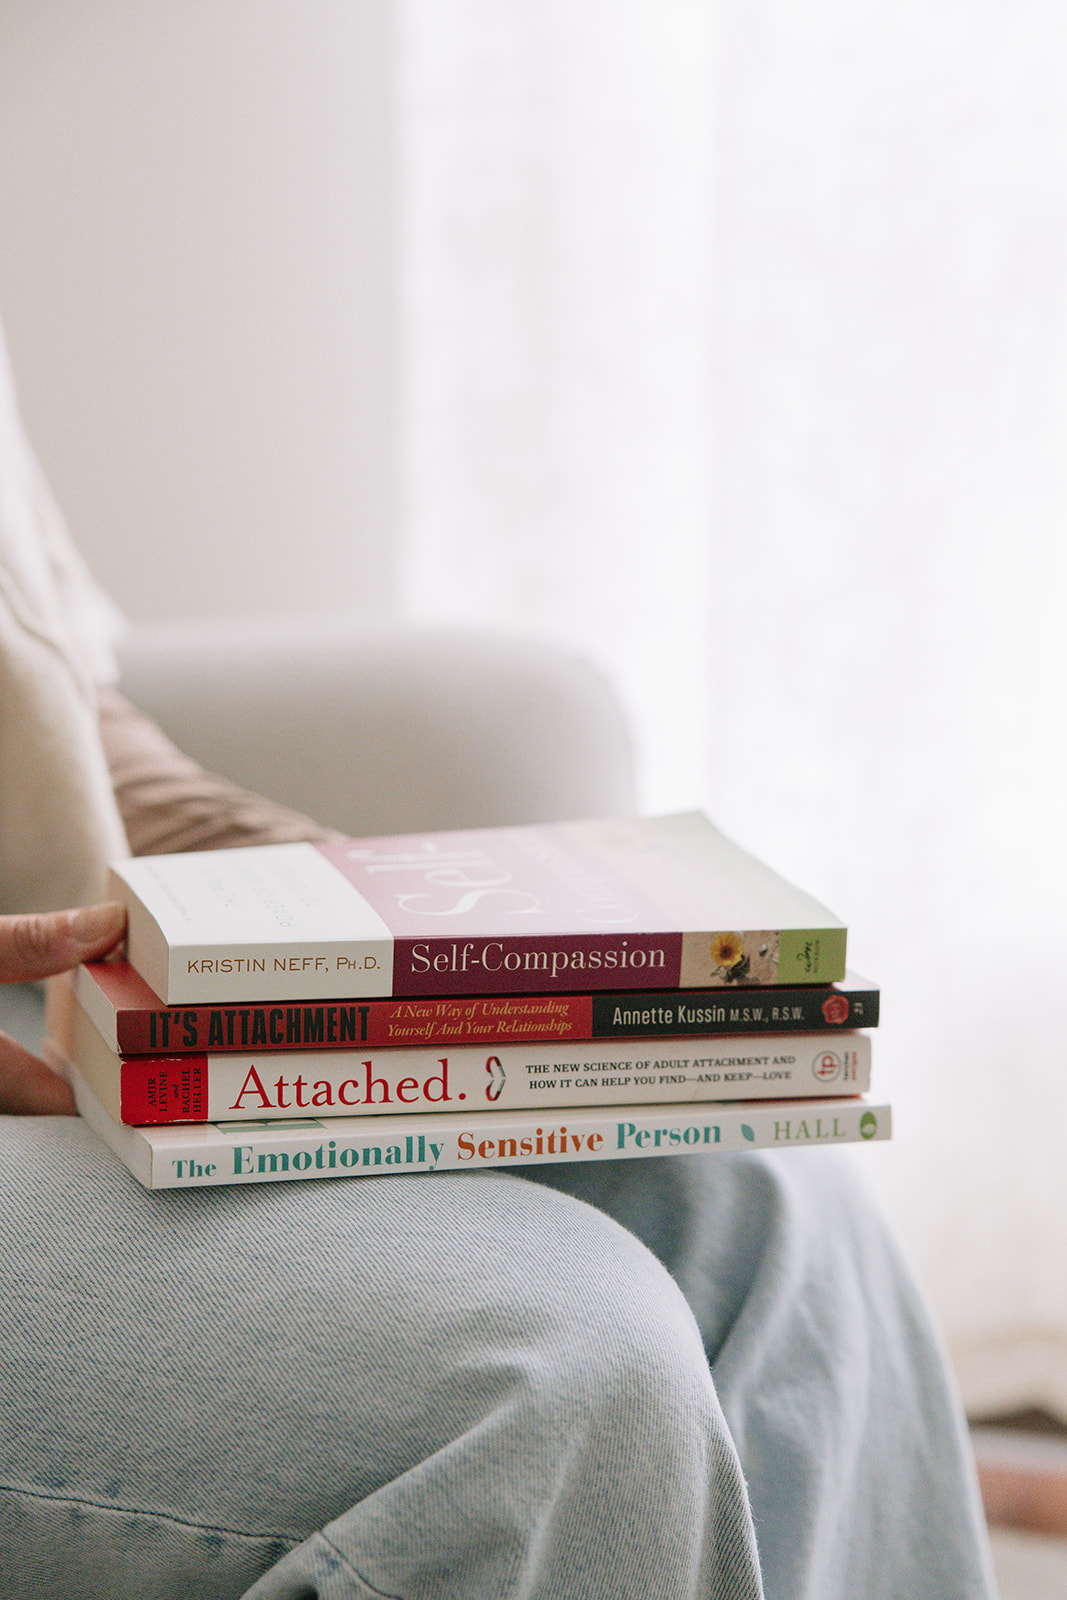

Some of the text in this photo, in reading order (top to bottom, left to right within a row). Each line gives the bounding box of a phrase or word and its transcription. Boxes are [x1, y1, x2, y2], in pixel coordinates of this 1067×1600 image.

[187, 959, 265, 973] KRISTIN
[274, 957, 329, 973] NEFF,
[410, 941, 666, 978] Self-Compassion
[390, 1000, 570, 1020] A New Way of Understanding
[613, 1006, 673, 1025] Annette
[678, 1005, 725, 1023] Kussin
[772, 1006, 805, 1021] R.S.W.
[149, 1006, 370, 1048] IT'S ATTACHMENT
[387, 1018, 573, 1039] Yourself And Your Relationships
[525, 1055, 796, 1074] THE NEW SCIENCE OF ADULT ATTACHMENT AND
[818, 1055, 837, 1076] tp
[148, 1078, 156, 1107] AMIR
[159, 1071, 168, 1112] LEVINE
[171, 1084, 179, 1098] and
[182, 1067, 190, 1113] RACHEL
[193, 1067, 201, 1113] HELLER
[228, 1058, 467, 1111] Attached.
[529, 1079, 557, 1089] HOW
[560, 1079, 571, 1088] IT
[575, 1078, 598, 1088] CAN
[601, 1077, 631, 1087] HELP
[633, 1075, 656, 1086] YOU
[172, 1117, 847, 1179] The Emotionally Sensitive Person HALL
